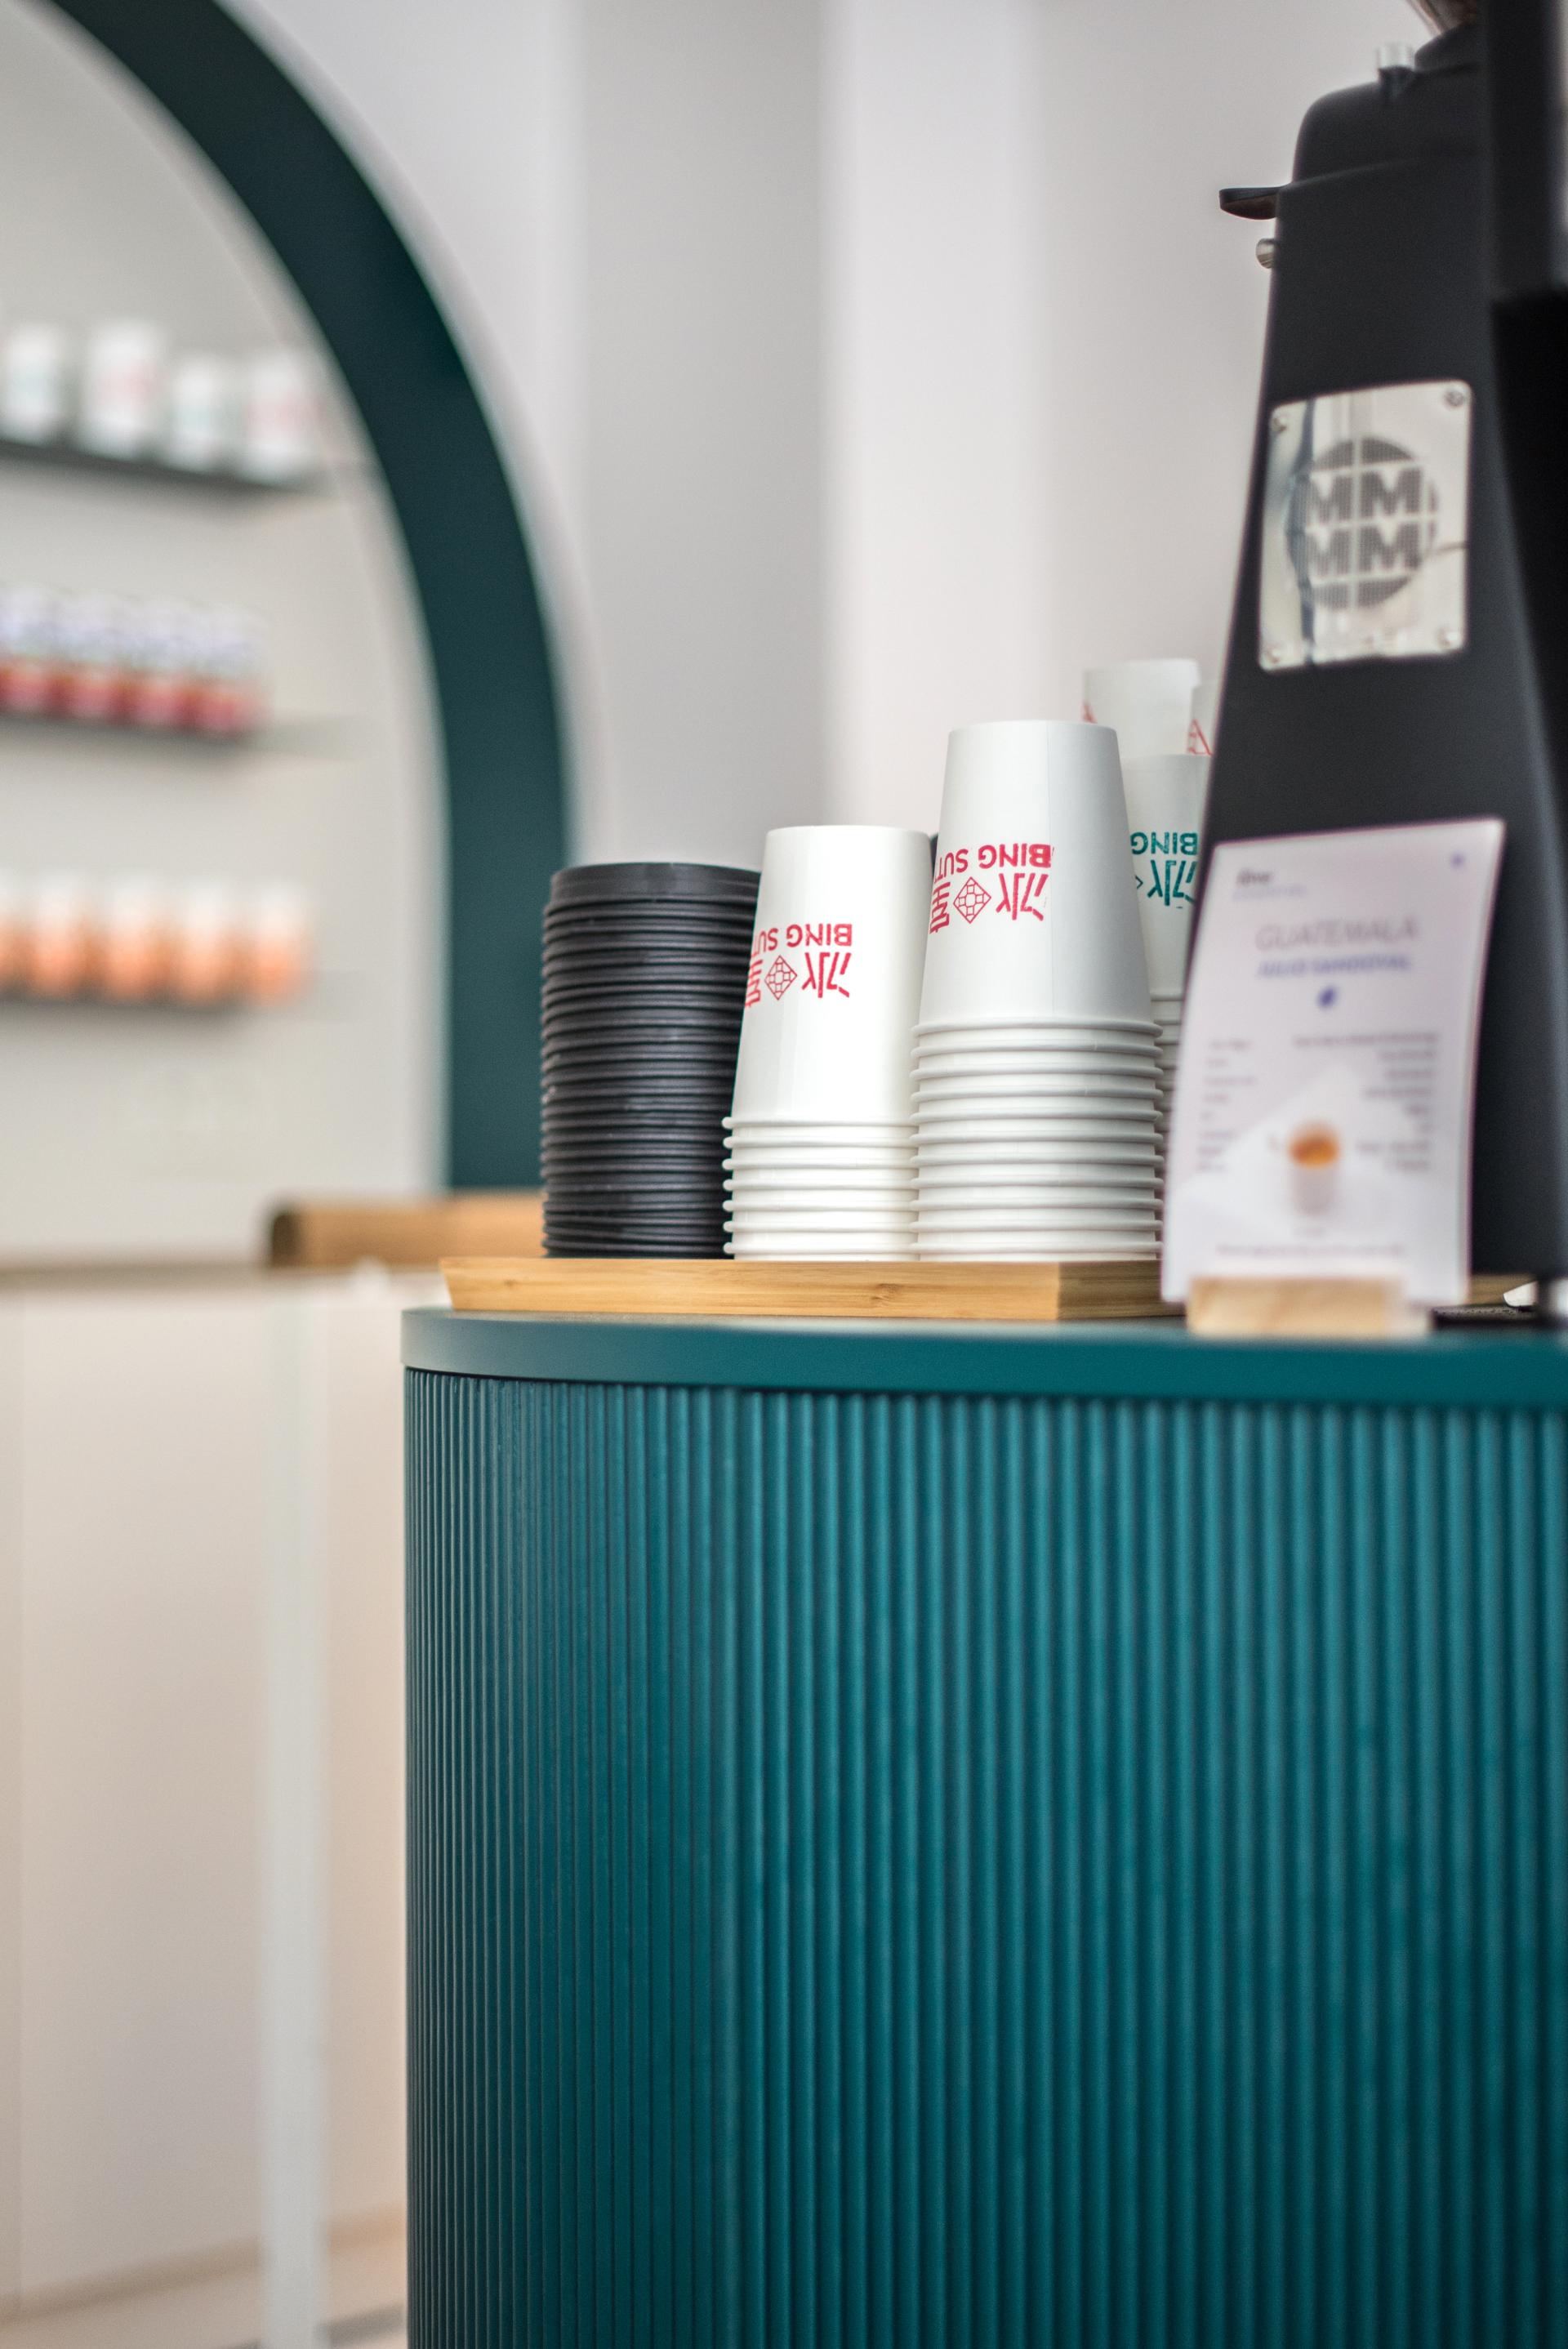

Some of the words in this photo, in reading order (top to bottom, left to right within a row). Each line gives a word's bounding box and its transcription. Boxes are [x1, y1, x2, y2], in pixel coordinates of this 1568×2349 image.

[978, 843, 1052, 869] BING
[1129, 831, 1199, 856] BING
[933, 848, 969, 884] SUT
[995, 872, 1049, 921] 冰
[786, 923, 853, 947] BING
[801, 952, 852, 998] 冰
